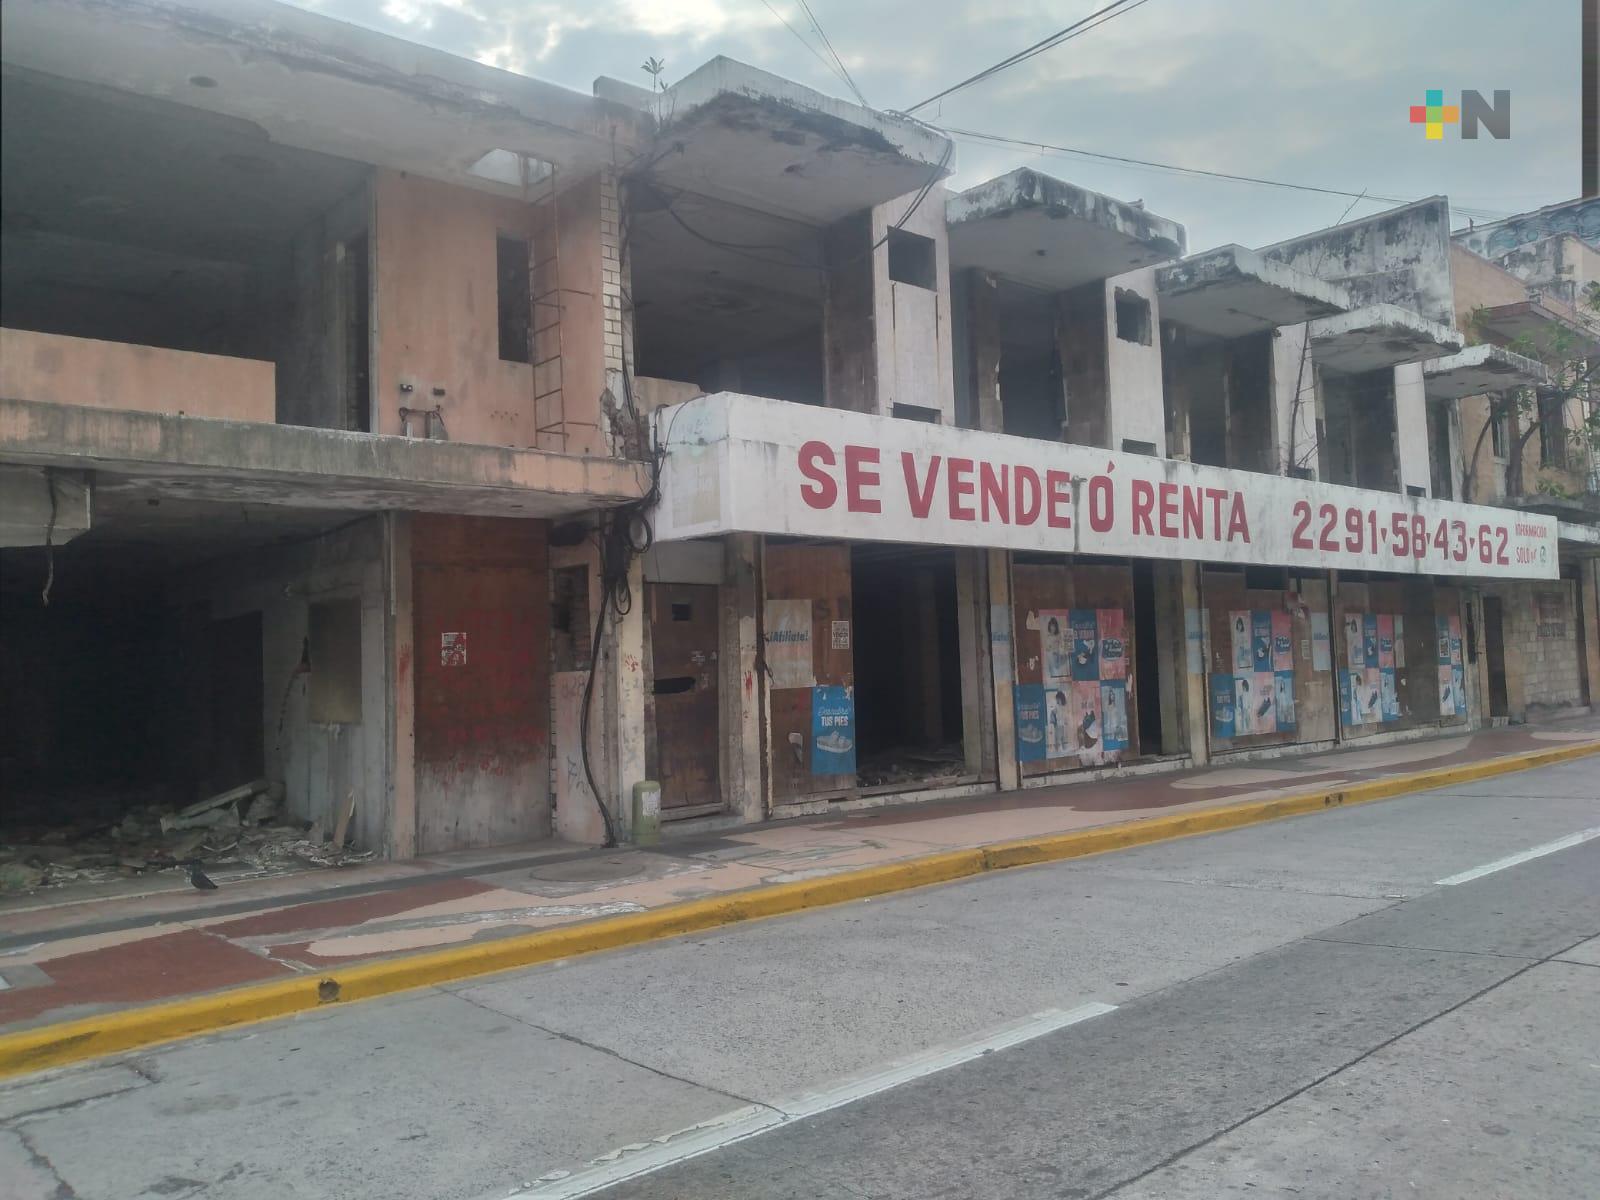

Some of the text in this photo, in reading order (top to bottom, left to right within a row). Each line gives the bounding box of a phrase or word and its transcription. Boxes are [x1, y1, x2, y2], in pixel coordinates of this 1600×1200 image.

[797, 440, 881, 514] SE
[901, 452, 1071, 529] VENDE
[1088, 460, 1114, 532] Ó
[1132, 479, 1250, 543] RENTA
